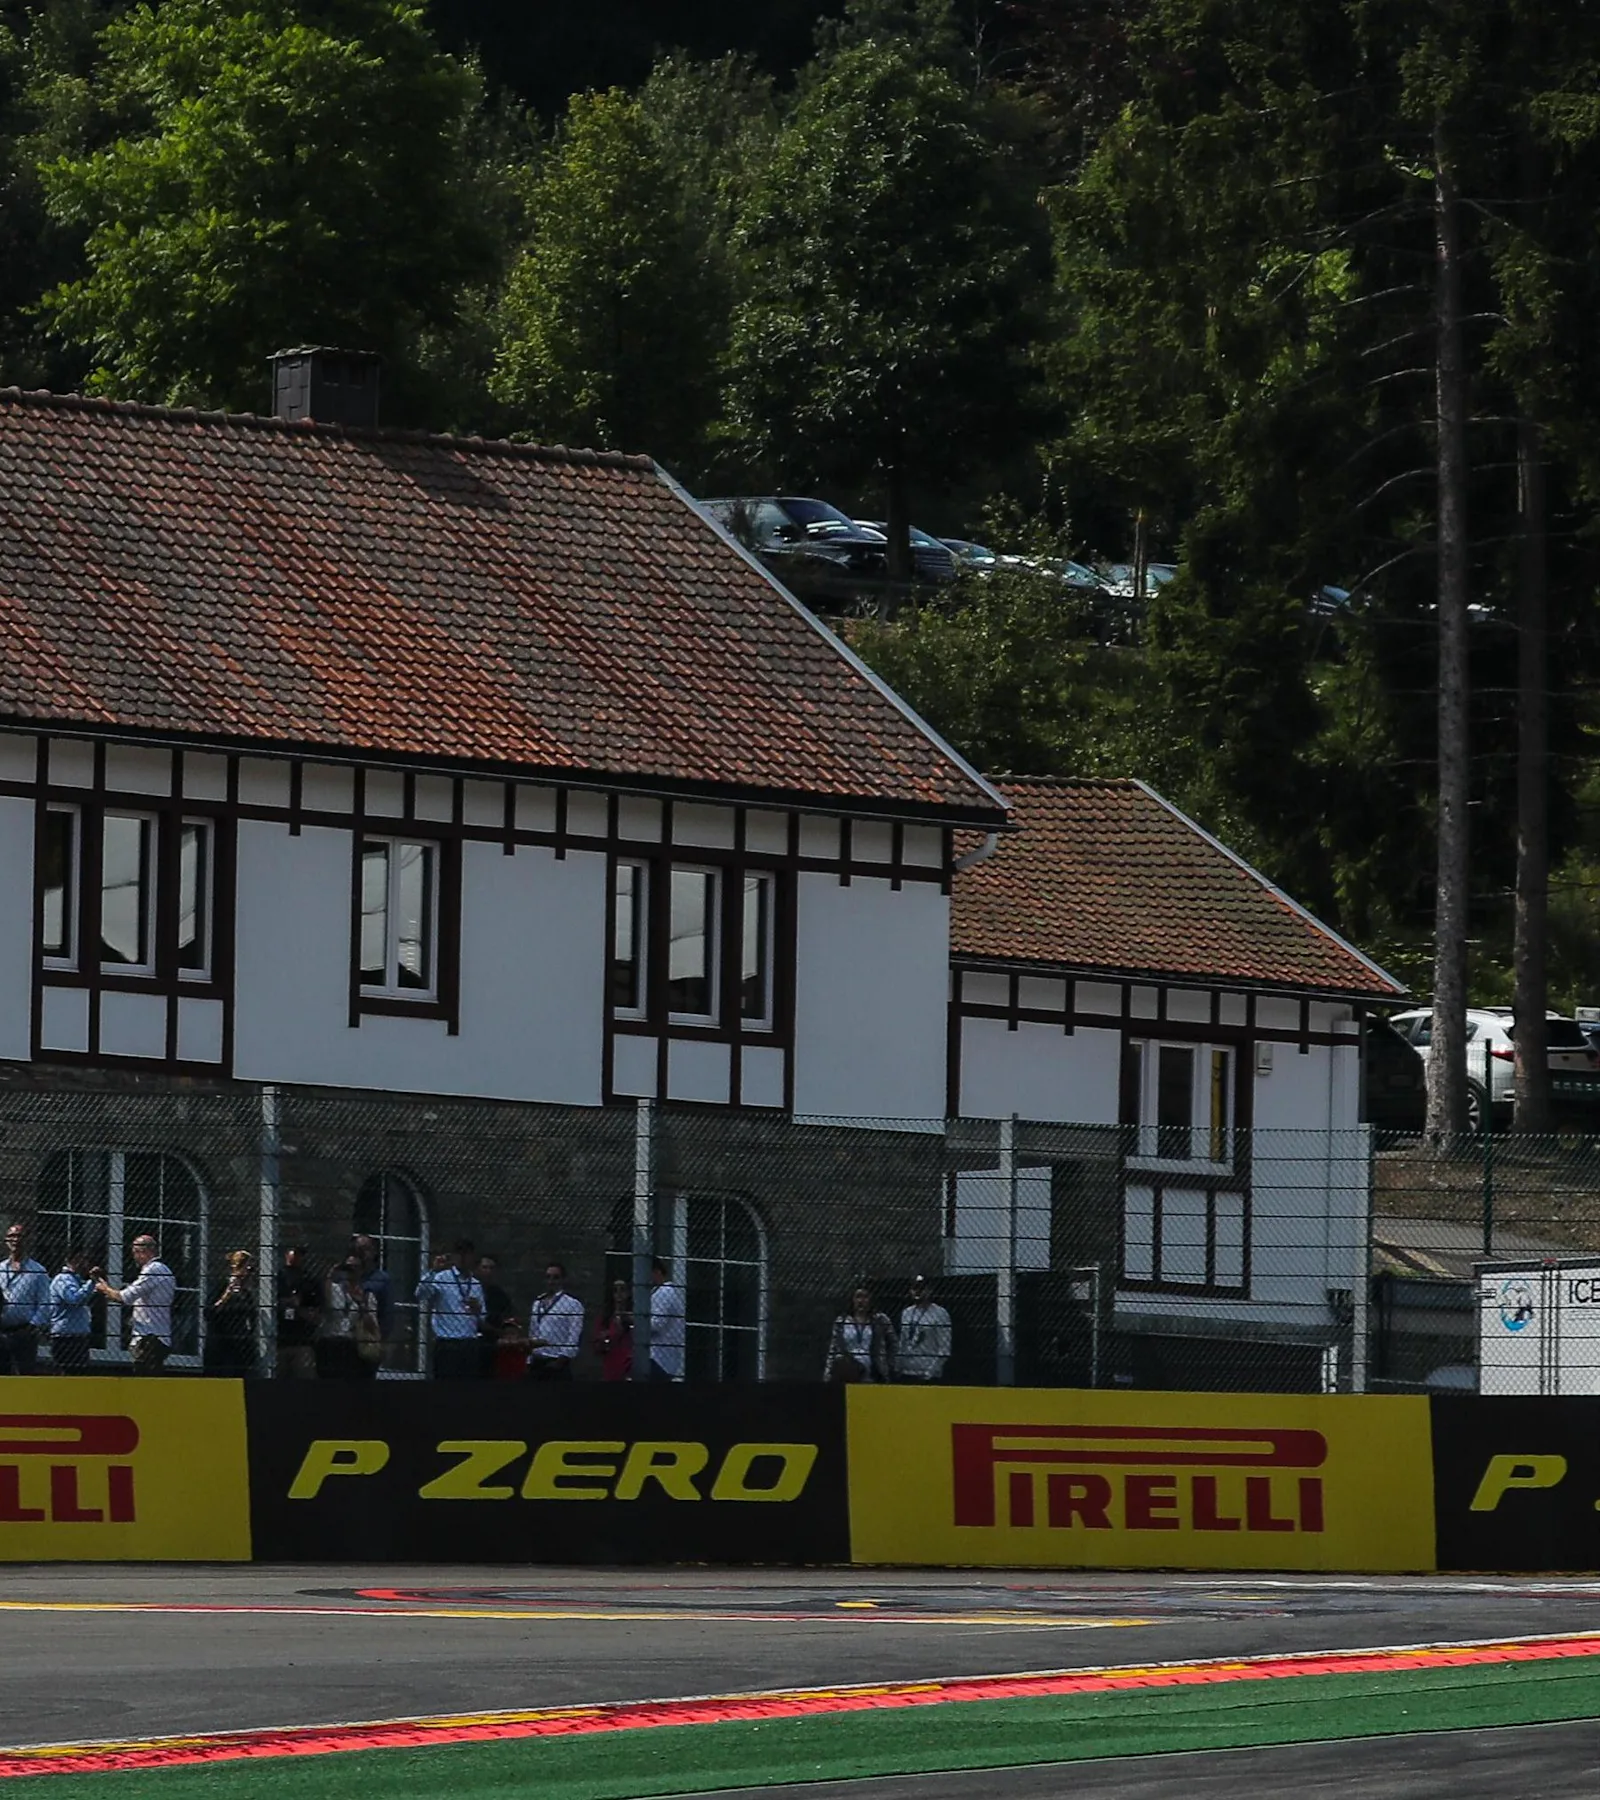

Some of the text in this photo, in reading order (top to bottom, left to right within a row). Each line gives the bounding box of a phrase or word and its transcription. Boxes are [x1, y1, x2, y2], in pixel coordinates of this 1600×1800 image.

[287, 1439, 819, 1501] P ZERO
[951, 1423, 1329, 1533] PIRELLI
[1468, 1454, 1568, 1512] P
